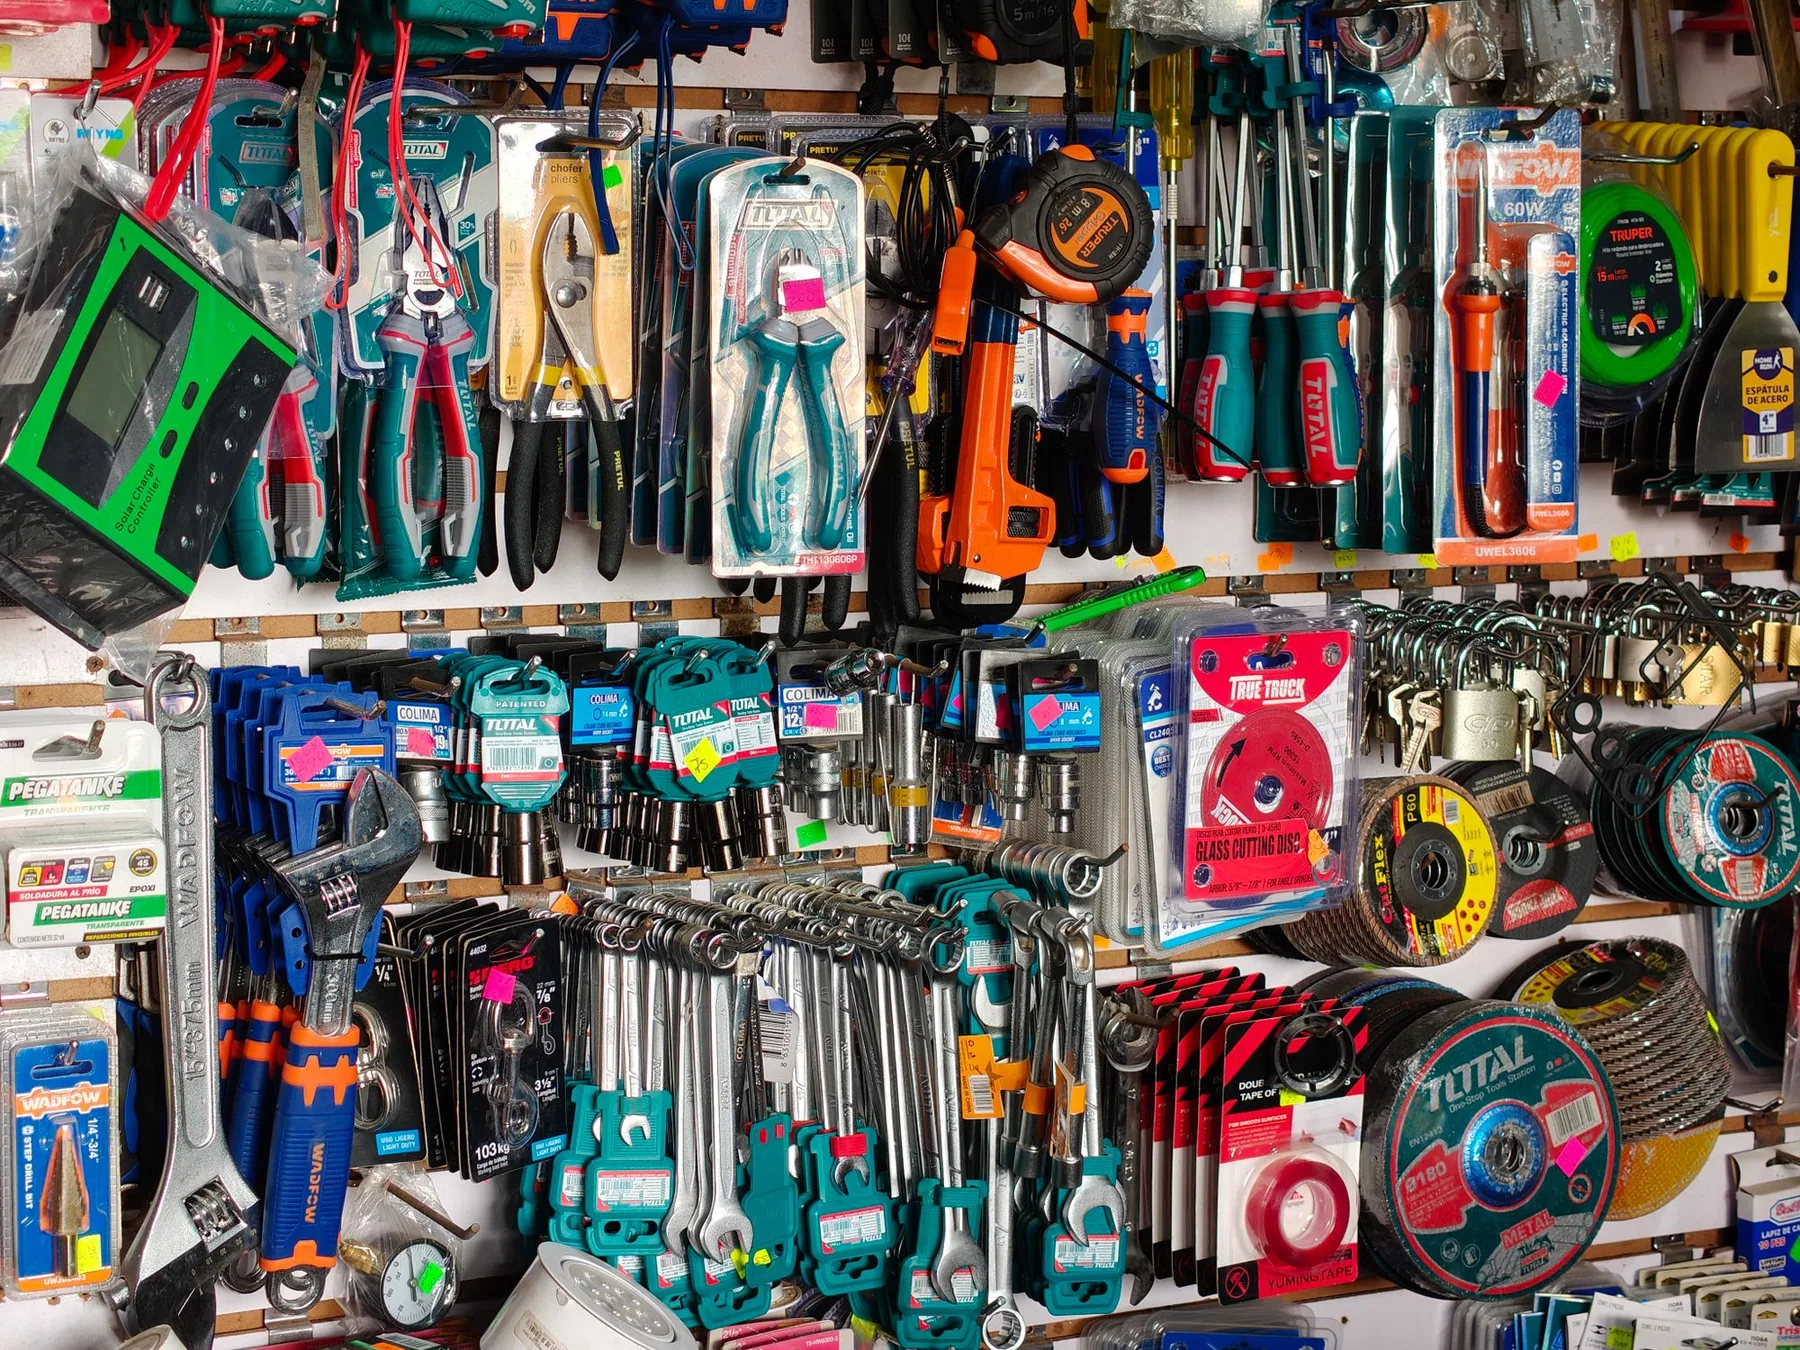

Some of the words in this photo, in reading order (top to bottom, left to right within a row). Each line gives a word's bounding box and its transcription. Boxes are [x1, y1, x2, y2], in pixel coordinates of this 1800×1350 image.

[738, 134, 765, 142] PRETU
[246, 144, 288, 161] TOTAL
[402, 143, 440, 156] TOTAL
[550, 163, 583, 173] chofer
[551, 173, 578, 184] pliers
[1080, 198, 1091, 208] 8
[1504, 202, 1544, 217] 60W
[752, 205, 821, 223] TOTAL
[1082, 216, 1119, 258] TRUPER
[1610, 226, 1653, 242] TRUPER
[1655, 260, 1661, 271] 2
[1597, 271, 1607, 282] 15
[1745, 384, 1790, 396] ESPÁTULA
[457, 378, 479, 431] TOTAL
[1747, 396, 1759, 405] DE
[1760, 394, 1789, 404] ACERO
[1305, 376, 1328, 458] TOTAL
[306, 419, 322, 465] TOTAL
[901, 420, 915, 470] PRETUL
[613, 449, 624, 492] PRETUL
[114, 501, 136, 532] Solar
[131, 463, 156, 501] Charge
[127, 477, 161, 534] Controller
[1475, 545, 1536, 557] UWEL3606
[1699, 655, 1715, 696] STAR
[784, 688, 834, 701] COLIMA
[1229, 675, 1263, 701] TRUE
[1262, 677, 1306, 705] TRUCK
[495, 700, 546, 708] PATENTED
[590, 694, 618, 704] COLIMA
[731, 697, 760, 712] TOTAL
[399, 707, 438, 721] COLIMA
[672, 707, 714, 728] TOTAL
[784, 713, 799, 728] 12
[486, 718, 538, 732] TOTAL
[434, 734, 445, 750] 19
[1153, 755, 1171, 765] BEST
[1283, 759, 1308, 787] Maximum
[8, 775, 125, 801] PEGATANKE
[24, 804, 111, 817] TRANSPARENTE
[1406, 793, 1418, 822] P60
[1773, 778, 1798, 856] TOTAL
[173, 767, 199, 929] WADFOW
[1195, 838, 1231, 863] GLASS
[1232, 835, 1275, 860] CUTTING
[1277, 832, 1302, 856] DISC
[19, 890, 68, 900] SOLDADURA
[69, 889, 81, 897] AL
[129, 884, 156, 893] EPOXI
[40, 899, 132, 921] PEGATANKE
[86, 920, 145, 930] TRANSPARENTE
[85, 933, 128, 941] REPARACIONES
[129, 930, 159, 938] INVISIBLES
[374, 963, 393, 982] 1/4"
[536, 986, 556, 1004] 7/8"
[735, 1022, 747, 1061] COLIMA
[1422, 1035, 1534, 1113] TOTAL
[1240, 1090, 1263, 1102] TAPE
[1264, 1088, 1278, 1098] OF
[1448, 1090, 1485, 1114] One-Stop
[1486, 1079, 1507, 1094] Tools
[1507, 1065, 1537, 1084] Station
[22, 1090, 100, 1111] WADFOW
[1240, 1118, 1261, 1127] SMOOTH
[1261, 1114, 1287, 1123] SURFACES
[24, 1137, 32, 1159] STEP
[382, 1143, 399, 1151] LIGHT
[24, 1160, 34, 1191] DRILL
[304, 1142, 326, 1224] WADFOW
[25, 1193, 34, 1209] BIT
[1501, 1210, 1550, 1247] METAL
[1761, 1229, 1781, 1239] LAPIZ
[1782, 1227, 1791, 1235] DE
